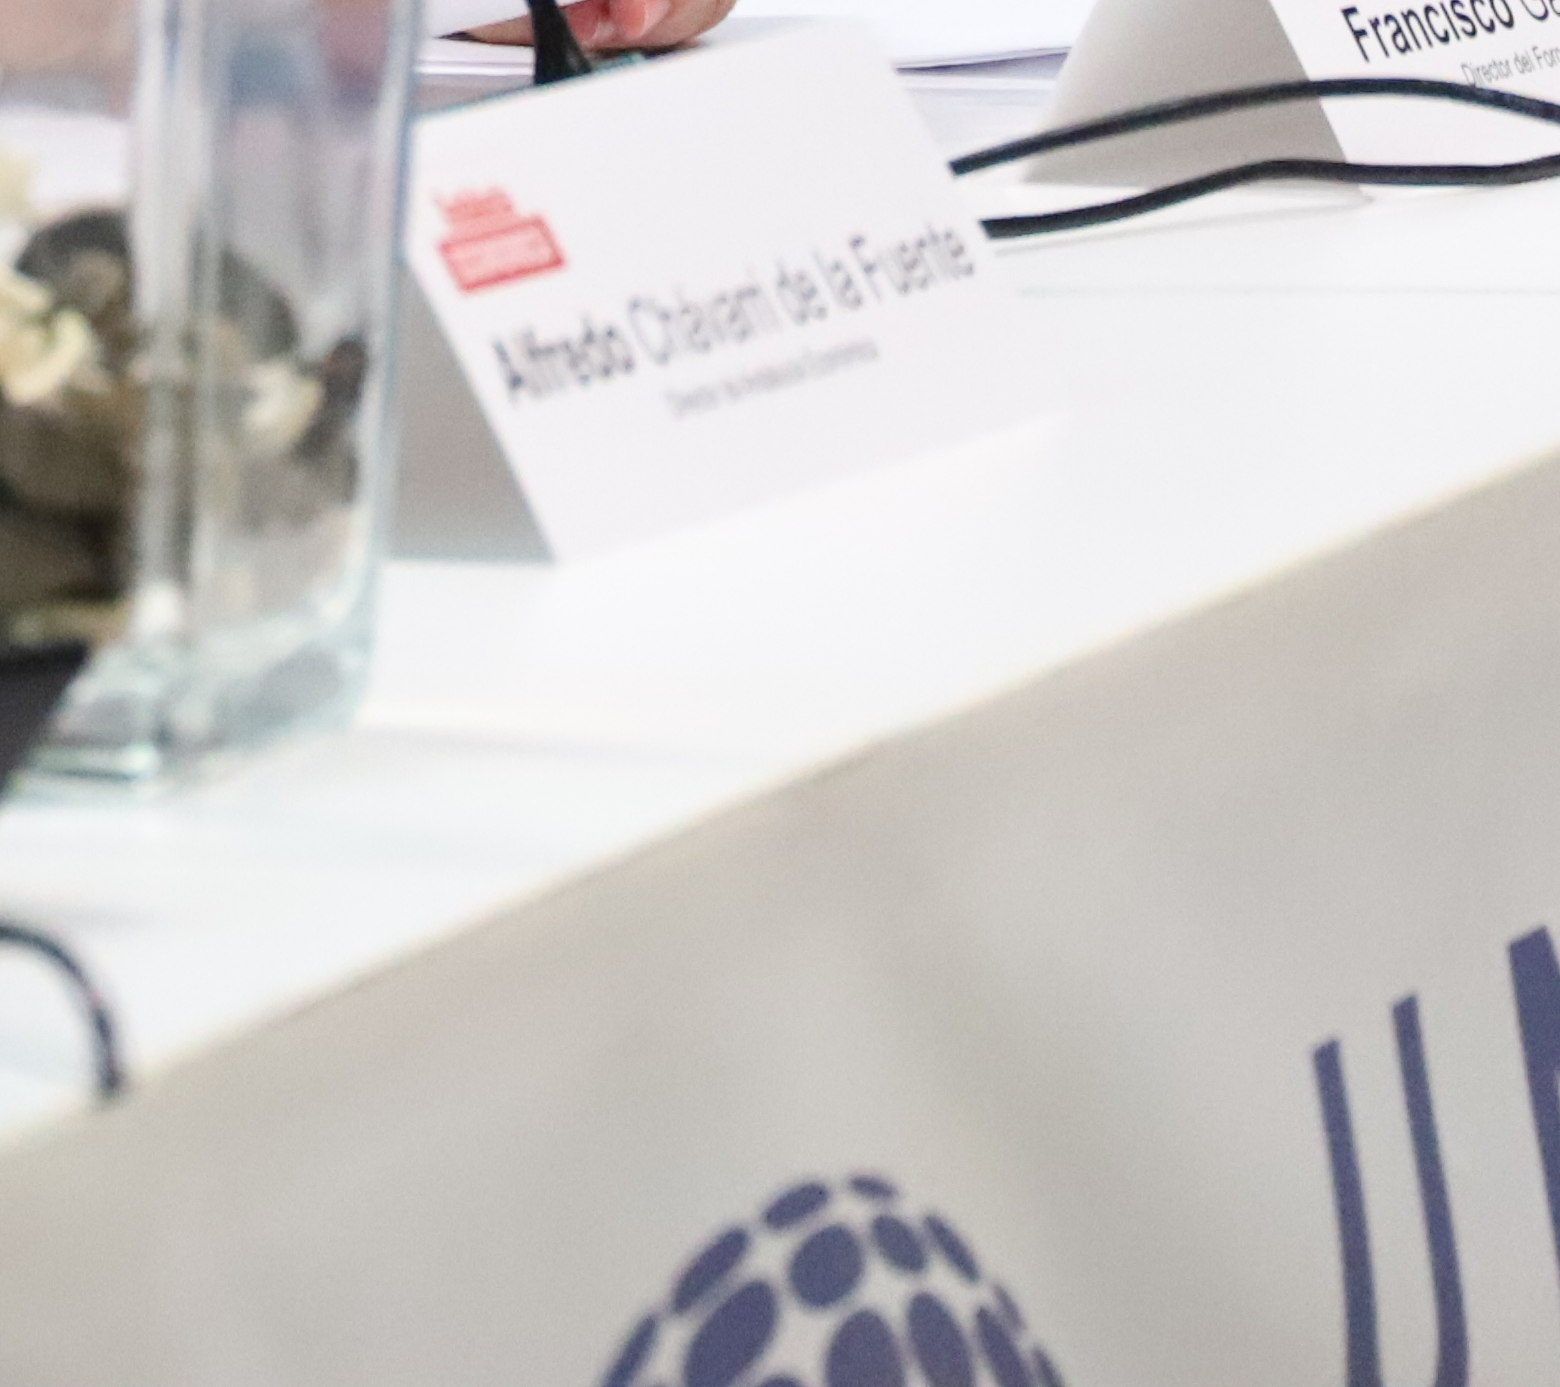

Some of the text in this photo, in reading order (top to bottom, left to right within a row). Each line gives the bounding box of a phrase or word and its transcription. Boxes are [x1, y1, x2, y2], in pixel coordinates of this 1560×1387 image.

[1460, 60, 1512, 89] Director
[1513, 52, 1534, 75] del
[773, 257, 829, 327] de
